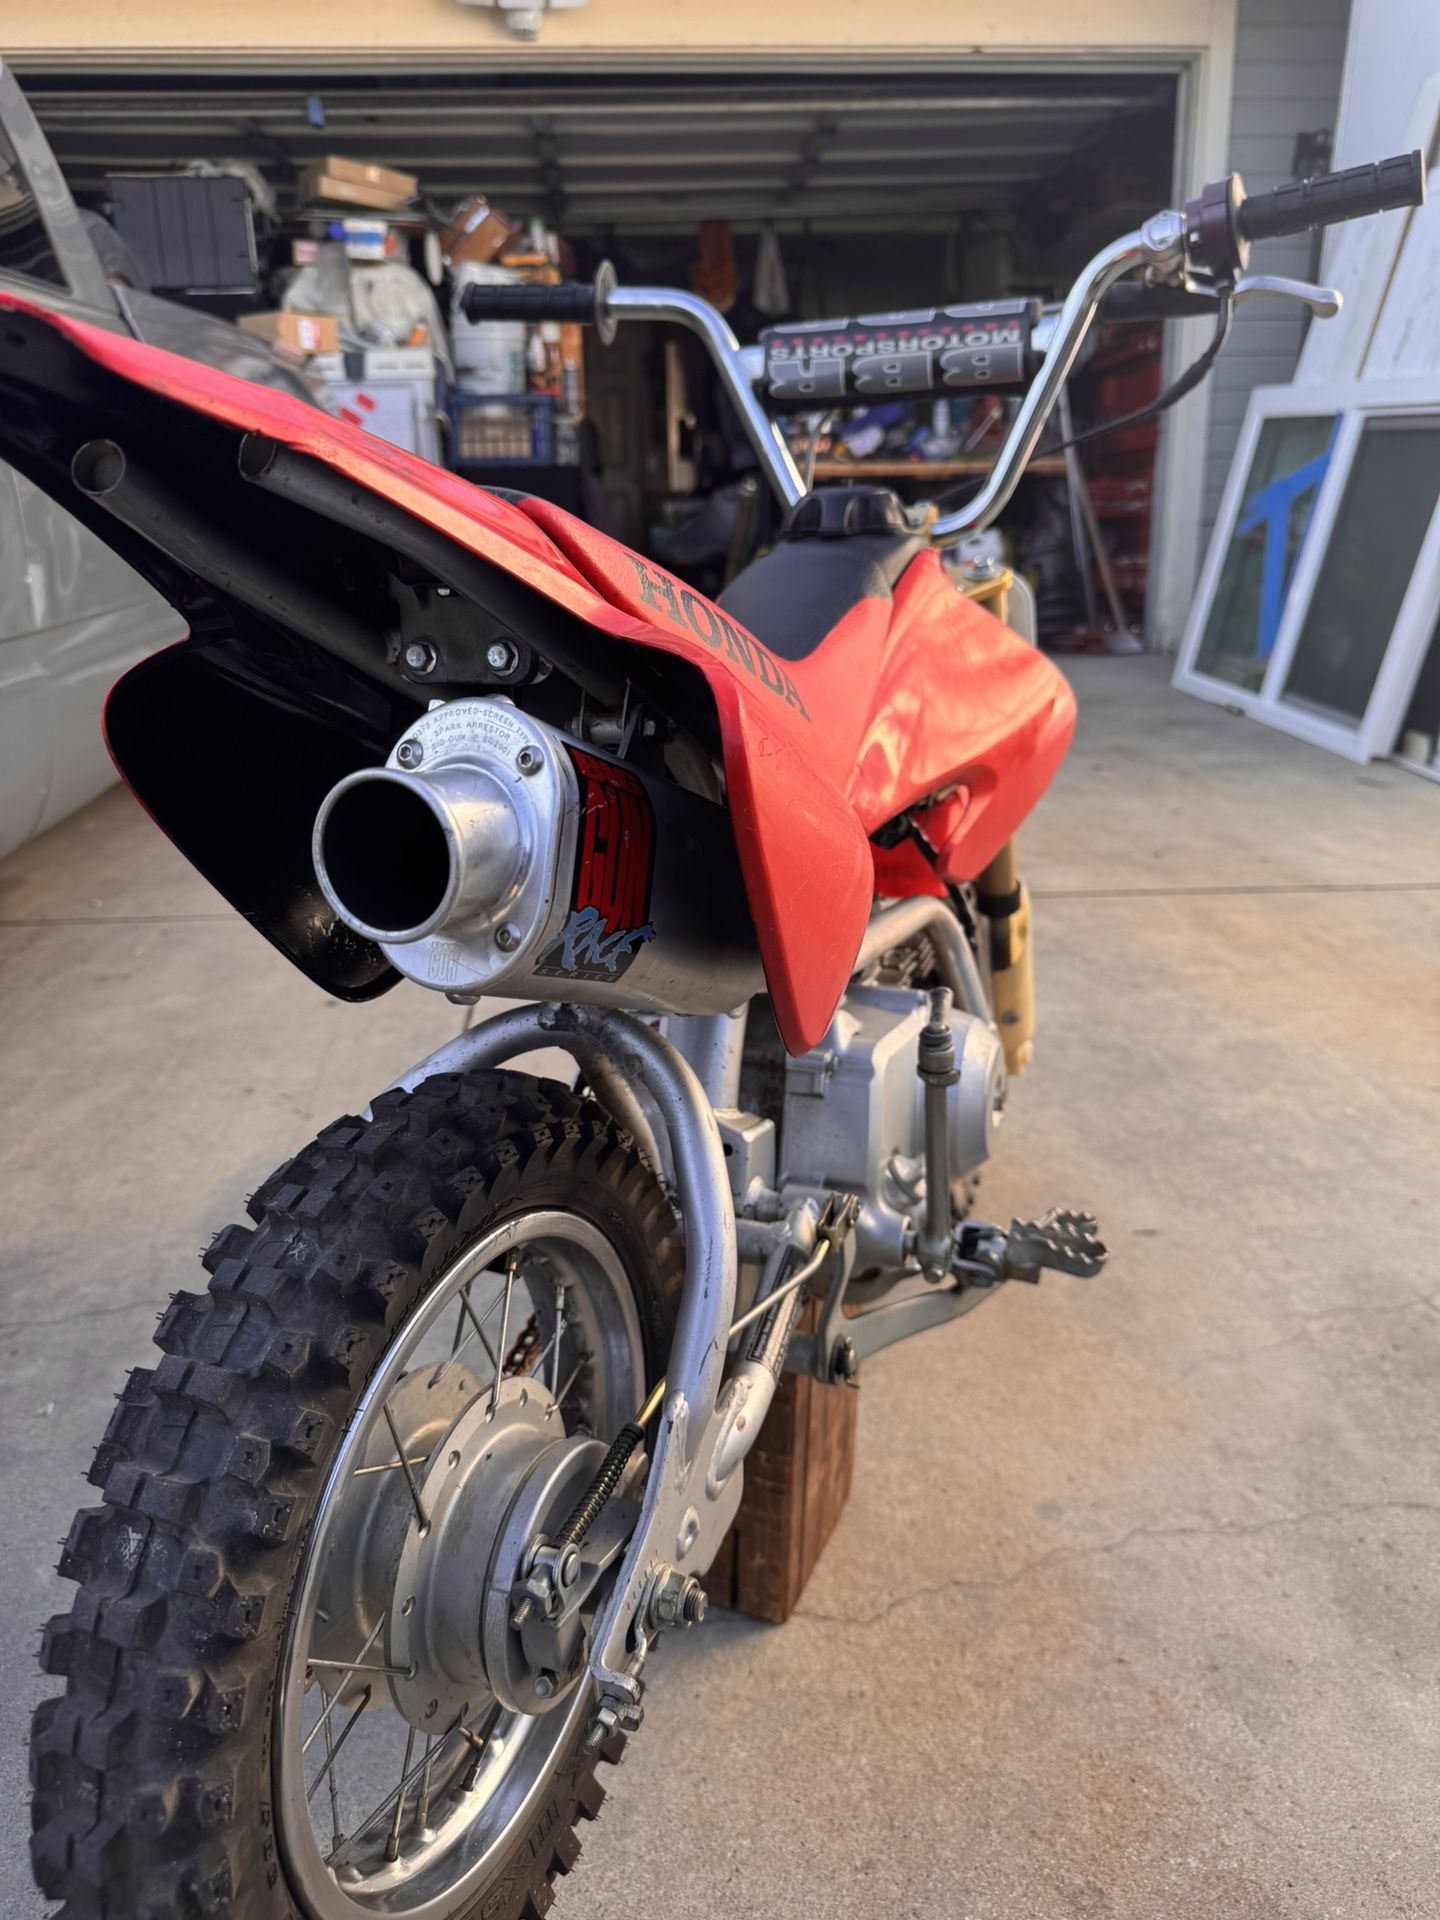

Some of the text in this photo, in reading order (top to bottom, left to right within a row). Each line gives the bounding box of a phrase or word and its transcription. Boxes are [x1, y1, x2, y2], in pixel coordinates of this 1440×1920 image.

[769, 328, 1021, 361] MOTORSPORTS
[767, 343, 1025, 400] BBR
[622, 551, 811, 722] HONDA
[433, 723, 462, 737] SPARK
[466, 721, 511, 740] ARRESTOR
[448, 734, 466, 743] GUN
[539, 968, 617, 984] SERIES
